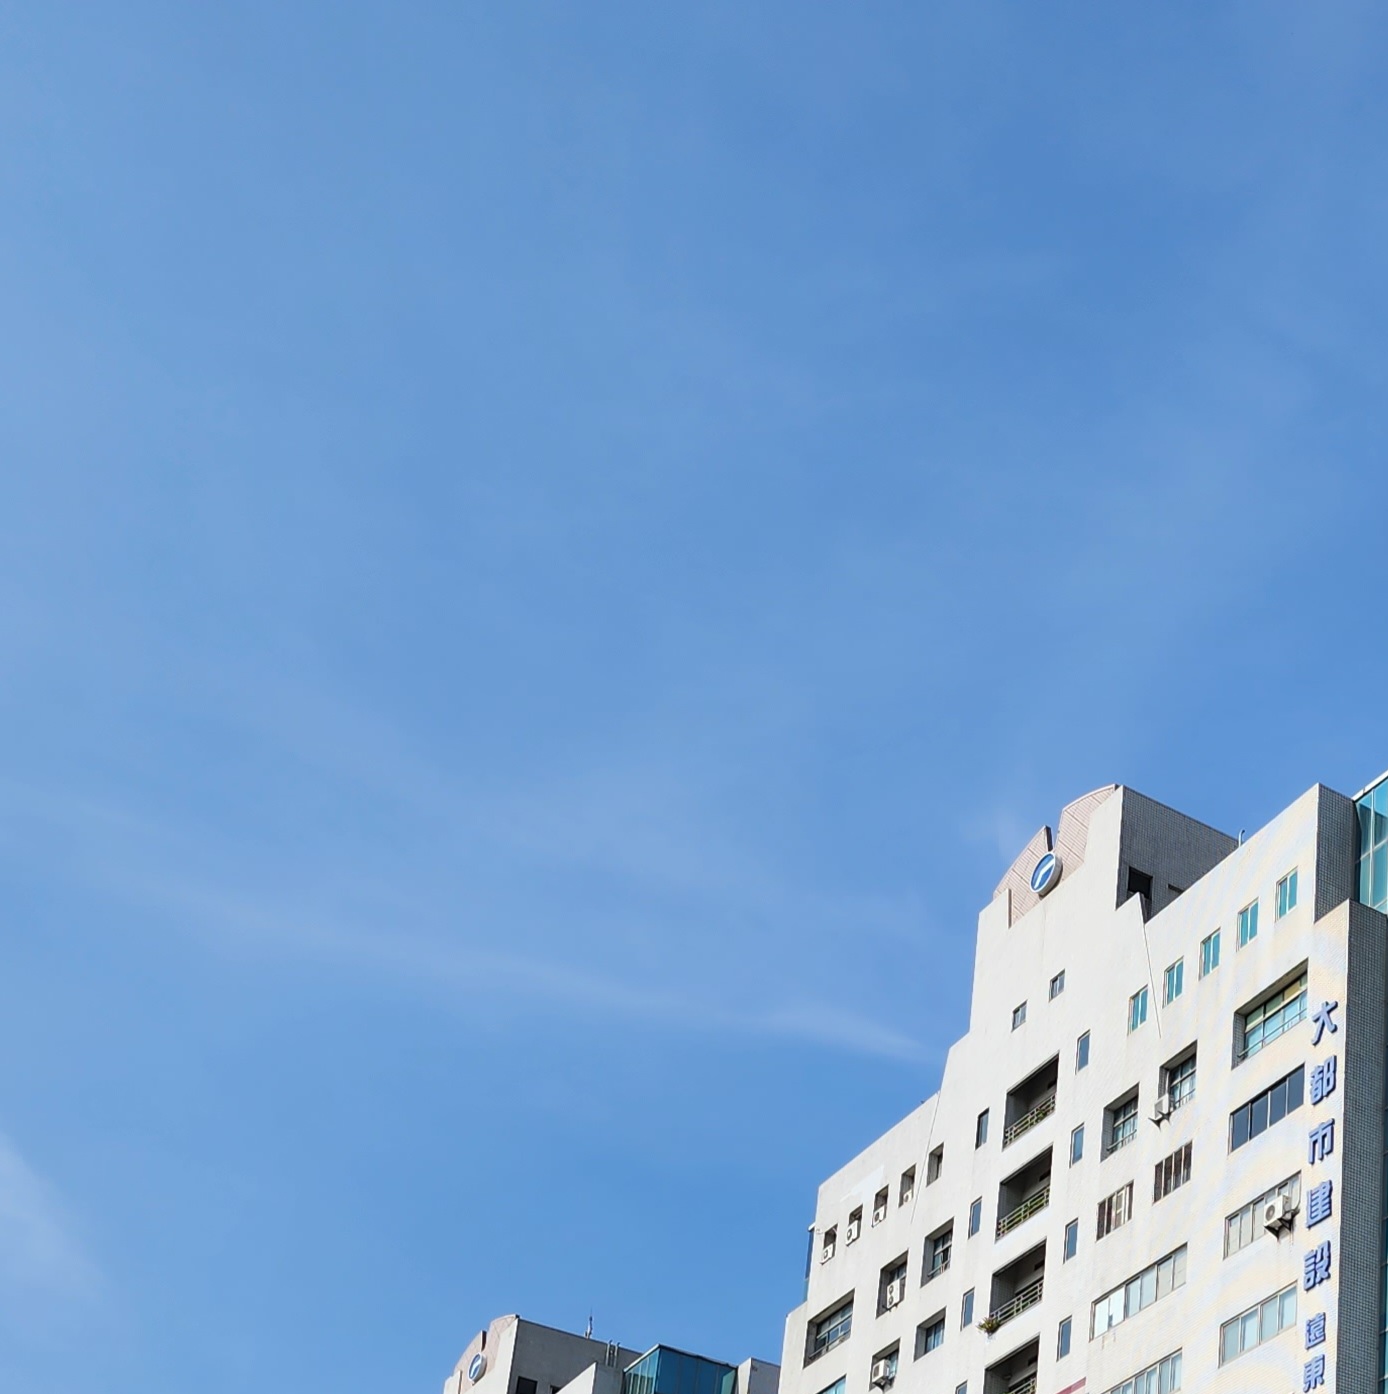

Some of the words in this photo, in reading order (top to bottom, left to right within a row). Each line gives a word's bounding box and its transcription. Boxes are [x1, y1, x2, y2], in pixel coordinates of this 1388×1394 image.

[1303, 1000, 1338, 1292] 大都市建設
